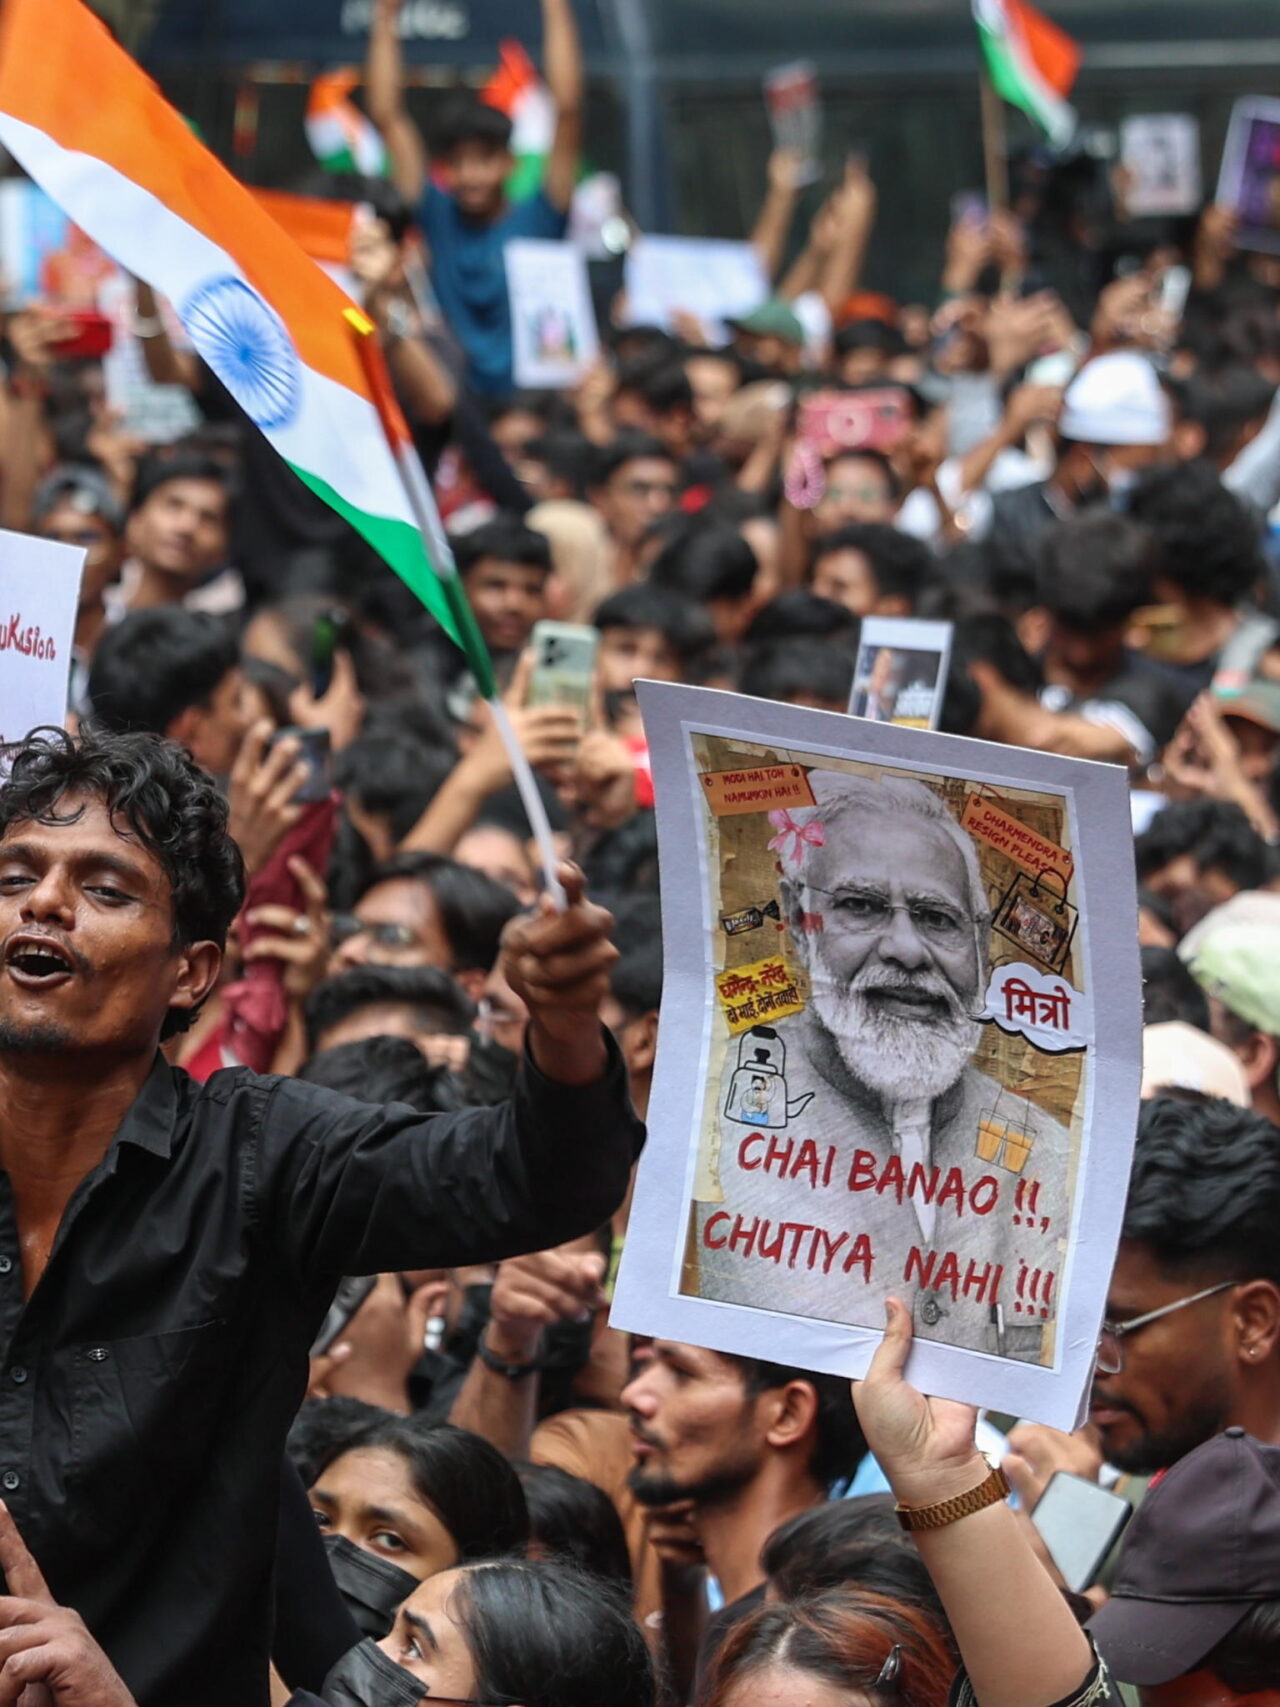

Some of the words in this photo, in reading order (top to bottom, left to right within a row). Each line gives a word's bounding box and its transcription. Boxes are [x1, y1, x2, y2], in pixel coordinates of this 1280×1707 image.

[722, 774, 746, 786] MODI
[747, 771, 764, 783] HAI
[766, 769, 785, 781] TOH
[775, 786, 791, 798] HAI
[967, 817, 1010, 848] RESIGN
[983, 811, 1058, 862] DHARMENDRA
[1000, 977, 1071, 1031] मित्रो
[737, 1131, 836, 1190] CHAI
[847, 1148, 1000, 1218] BANAO
[702, 1210, 875, 1285] CHUTIYA
[903, 1245, 1004, 1307] NAHI
[1013, 1256, 1055, 1319] !!!
